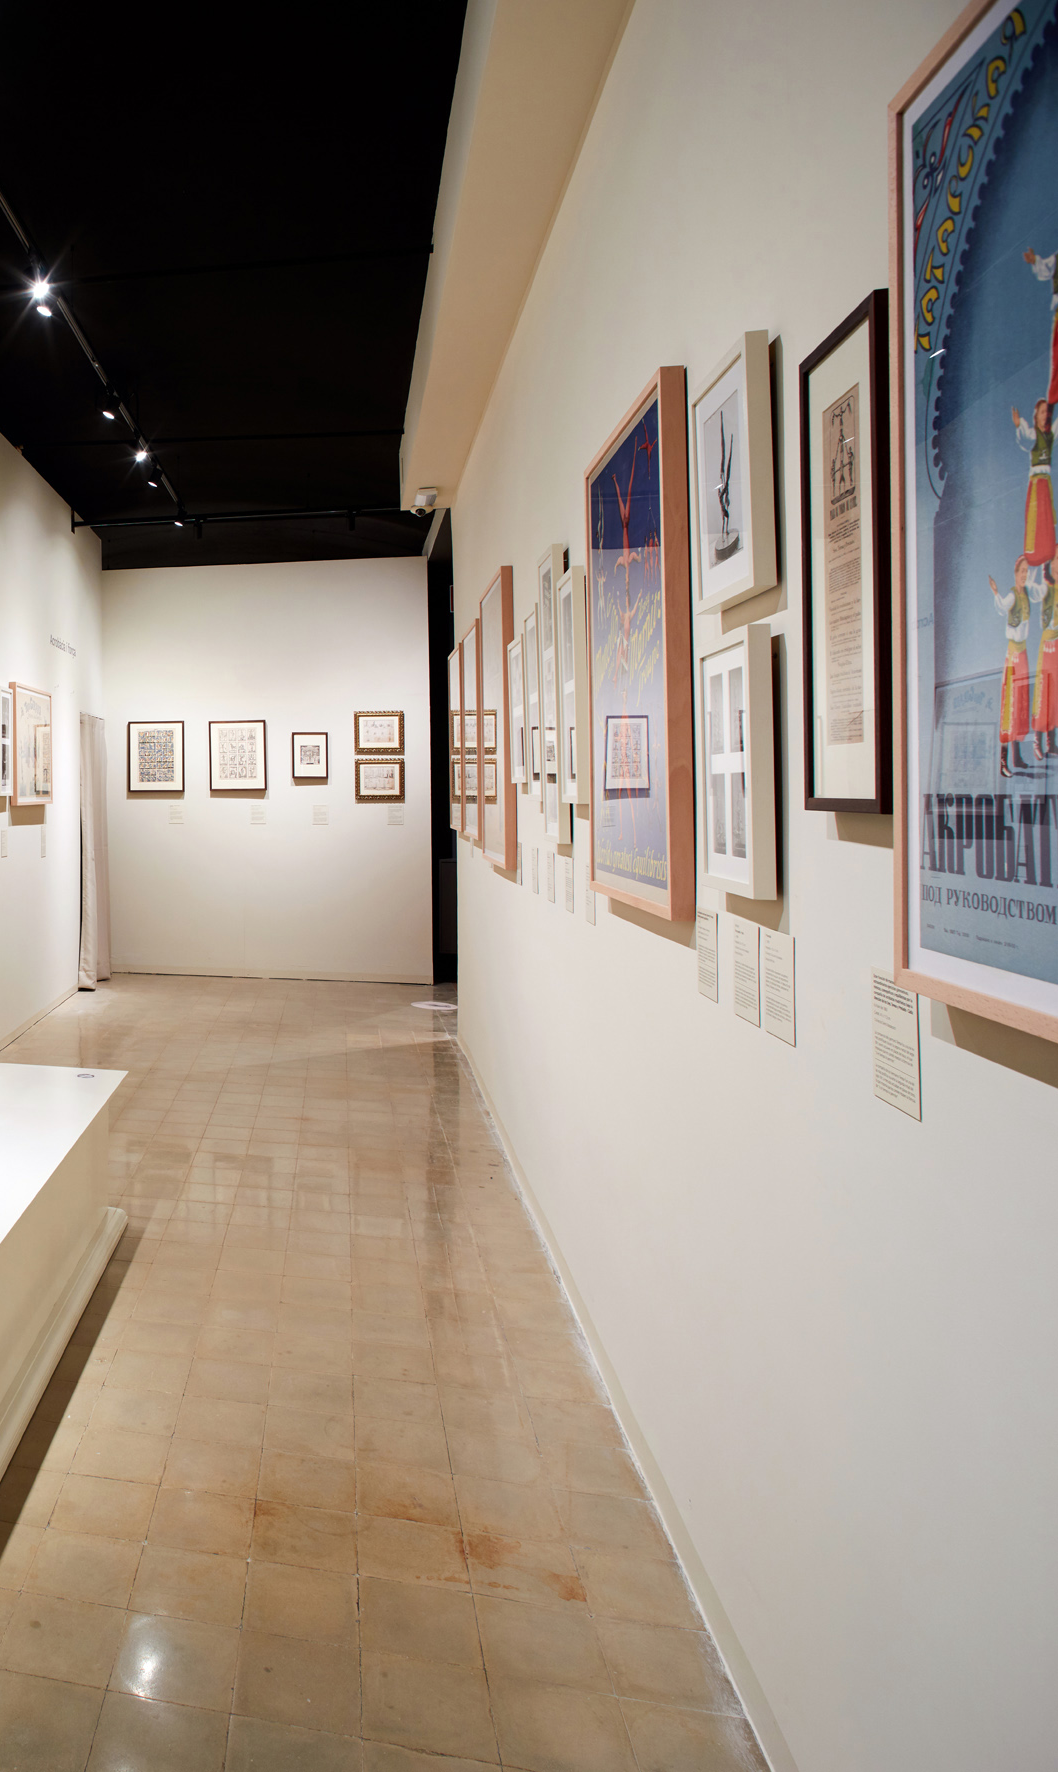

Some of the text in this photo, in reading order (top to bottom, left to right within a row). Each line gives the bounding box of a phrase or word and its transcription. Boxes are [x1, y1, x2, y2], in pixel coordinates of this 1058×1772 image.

[919, 793, 1058, 889] АКРОБАТ
[921, 884, 1058, 926] ПОД РУКОВОДСТВОМ
